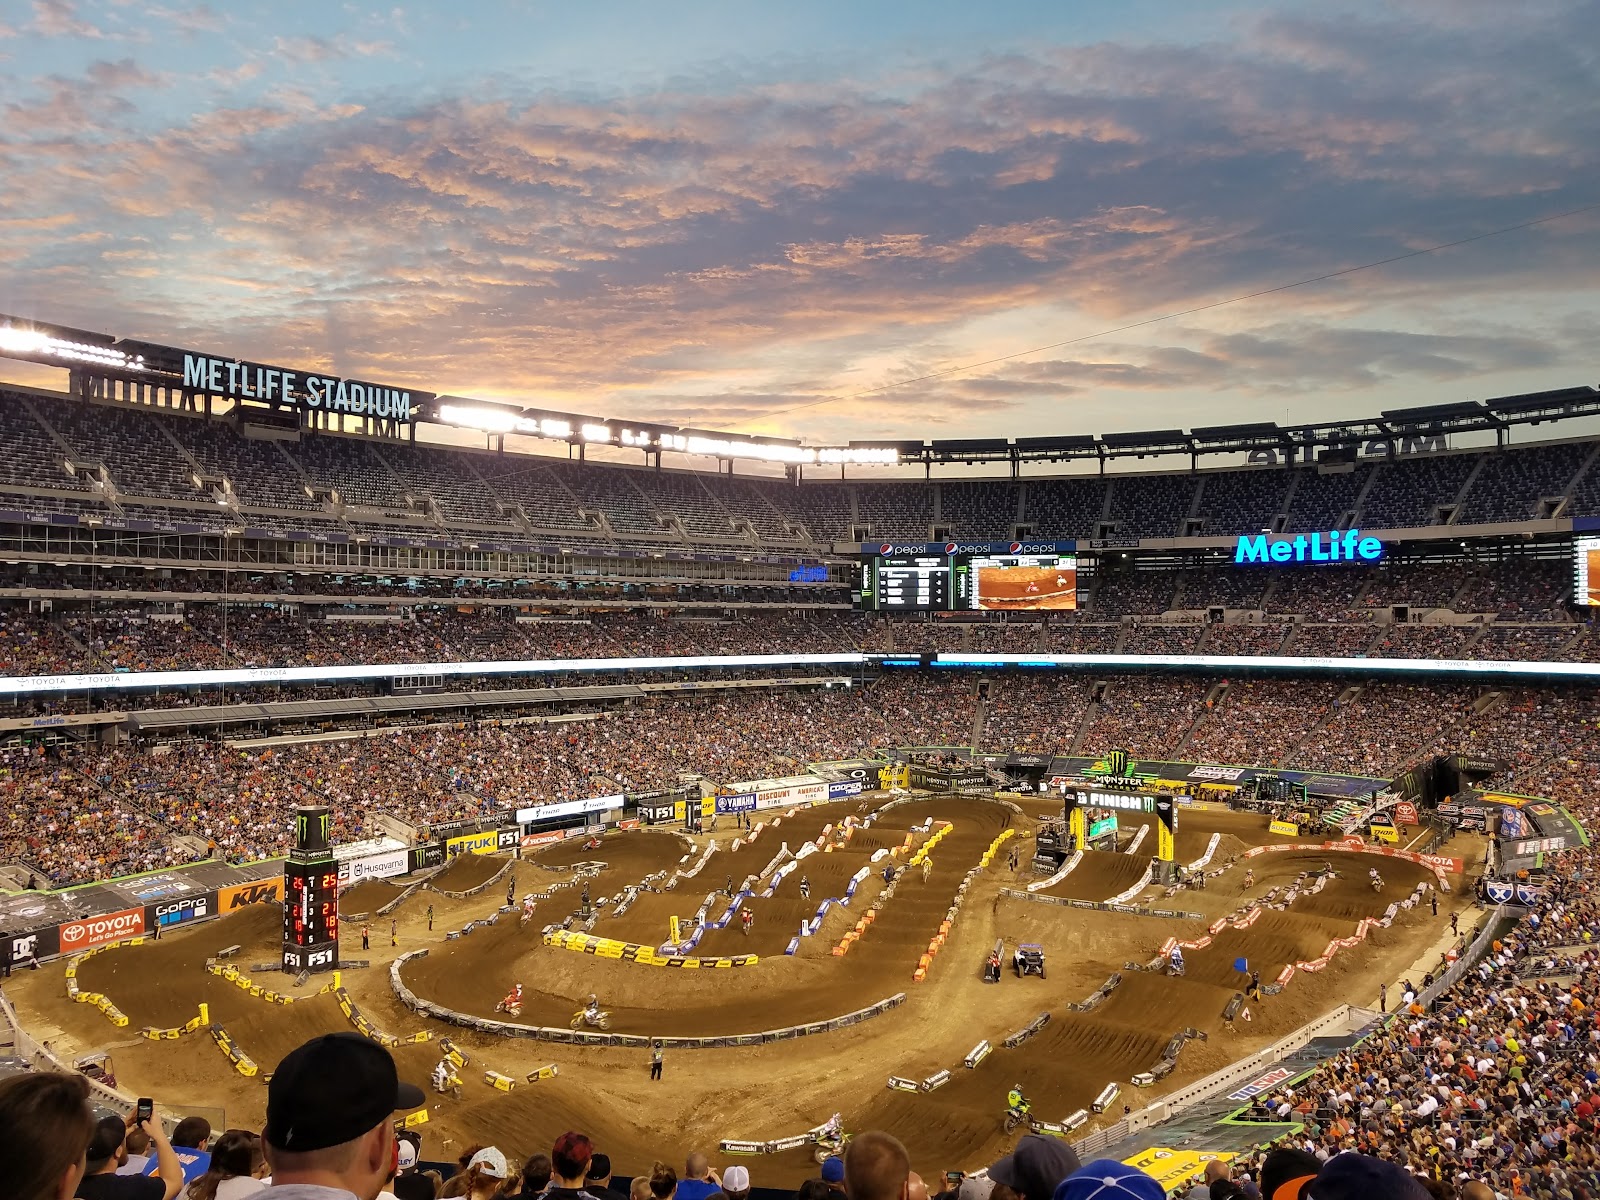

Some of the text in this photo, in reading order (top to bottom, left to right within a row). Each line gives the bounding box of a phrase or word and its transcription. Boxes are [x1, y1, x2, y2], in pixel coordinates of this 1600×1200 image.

[183, 354, 410, 420] METLIFE STADIUM
[894, 544, 926, 555] pepsi
[957, 543, 991, 555] pepsi
[1022, 542, 1056, 554] pepsi
[1235, 528, 1382, 563] MetLife
[259, 669, 287, 677] TOYOTA
[33, 717, 65, 727] MetLife
[926, 777, 949, 786] MONSTER
[1095, 775, 1143, 786] MONSTER
[797, 786, 824, 795] AMERICA'S
[830, 782, 861, 792] COOPER
[1009, 785, 1033, 793] TOYOTA
[758, 790, 791, 800] DISCOUNT
[1090, 792, 1142, 809] FINISH
[727, 796, 755, 807] YAMAHA
[656, 806, 674, 818] FS1
[430, 822, 462, 831] MONSTER
[1270, 824, 1297, 833] SUZUKI
[498, 831, 520, 845] FS1
[529, 836, 560, 845] HONDA
[364, 859, 404, 874] Husqvarna
[116, 873, 170, 889] GoPro
[293, 877, 302, 889] 25
[309, 880, 314, 888] 1
[322, 874, 336, 887] 25
[131, 881, 185, 896] GoPro
[1493, 889, 1507, 900] X
[230, 883, 278, 909] KTM
[309, 894, 314, 902] 2
[155, 897, 207, 916] GoPro
[322, 902, 336, 914] 21
[86, 913, 142, 935] TOYOTA
[309, 916, 336, 929] 4 18
[88, 934, 104, 943] Let's
[114, 927, 135, 936] Places
[329, 929, 336, 939] 4
[284, 952, 301, 967] FS1
[308, 949, 333, 967] FS1
[1228, 1068, 1291, 1100] AMSOIL
[725, 1144, 757, 1152] Kawasaki
[776, 1138, 805, 1150] Kawasaki
